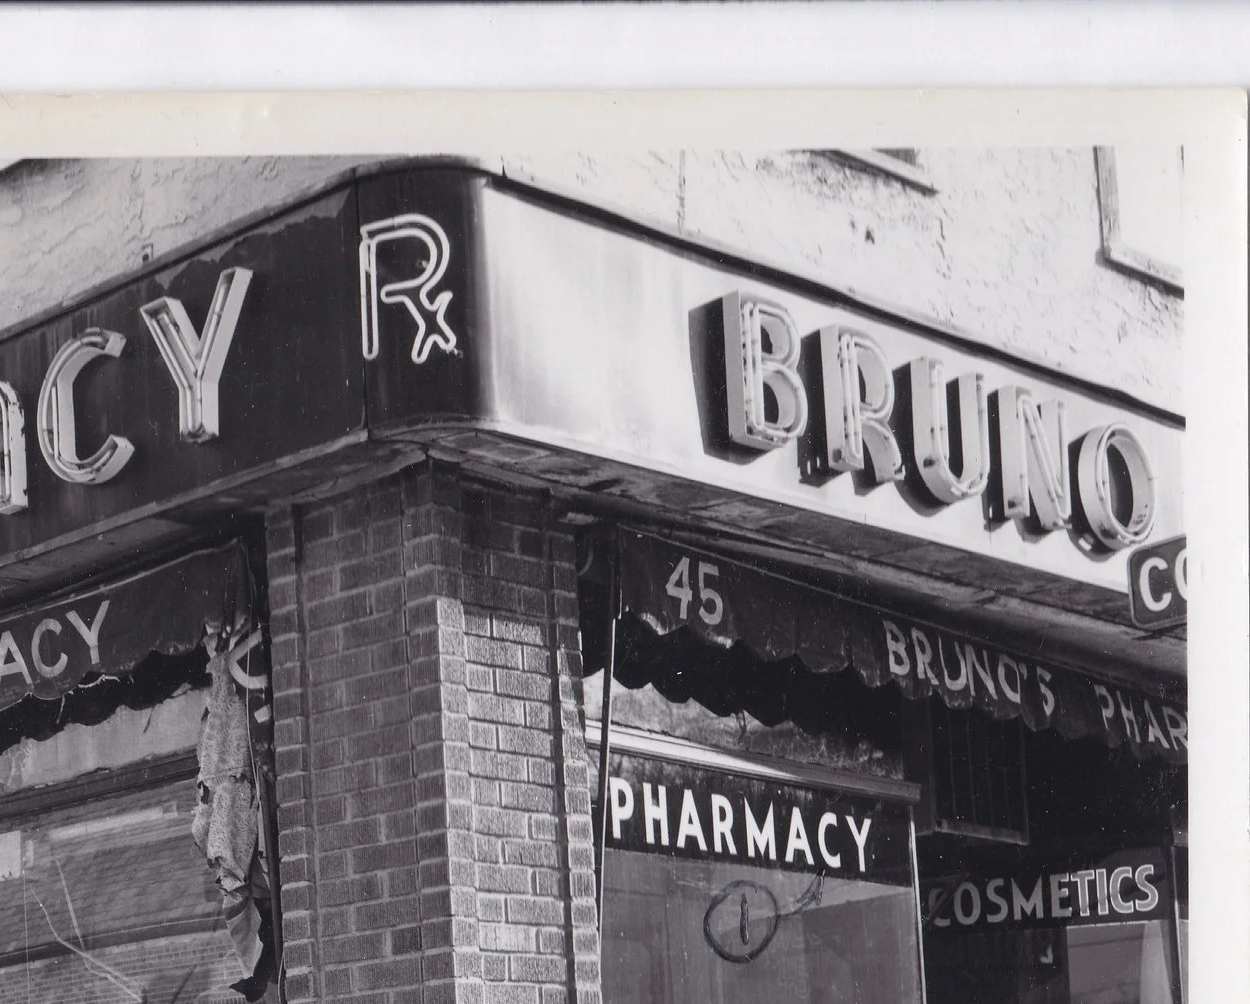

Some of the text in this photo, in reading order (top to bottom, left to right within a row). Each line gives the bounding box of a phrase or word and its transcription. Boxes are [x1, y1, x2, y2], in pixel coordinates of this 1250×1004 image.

[722, 289, 1157, 549] BRUNO
[665, 556, 724, 626] 45
[883, 620, 1055, 717] BRUNO'S
[609, 776, 873, 873] PHARMACY
[928, 864, 1160, 927] COSMETICS
